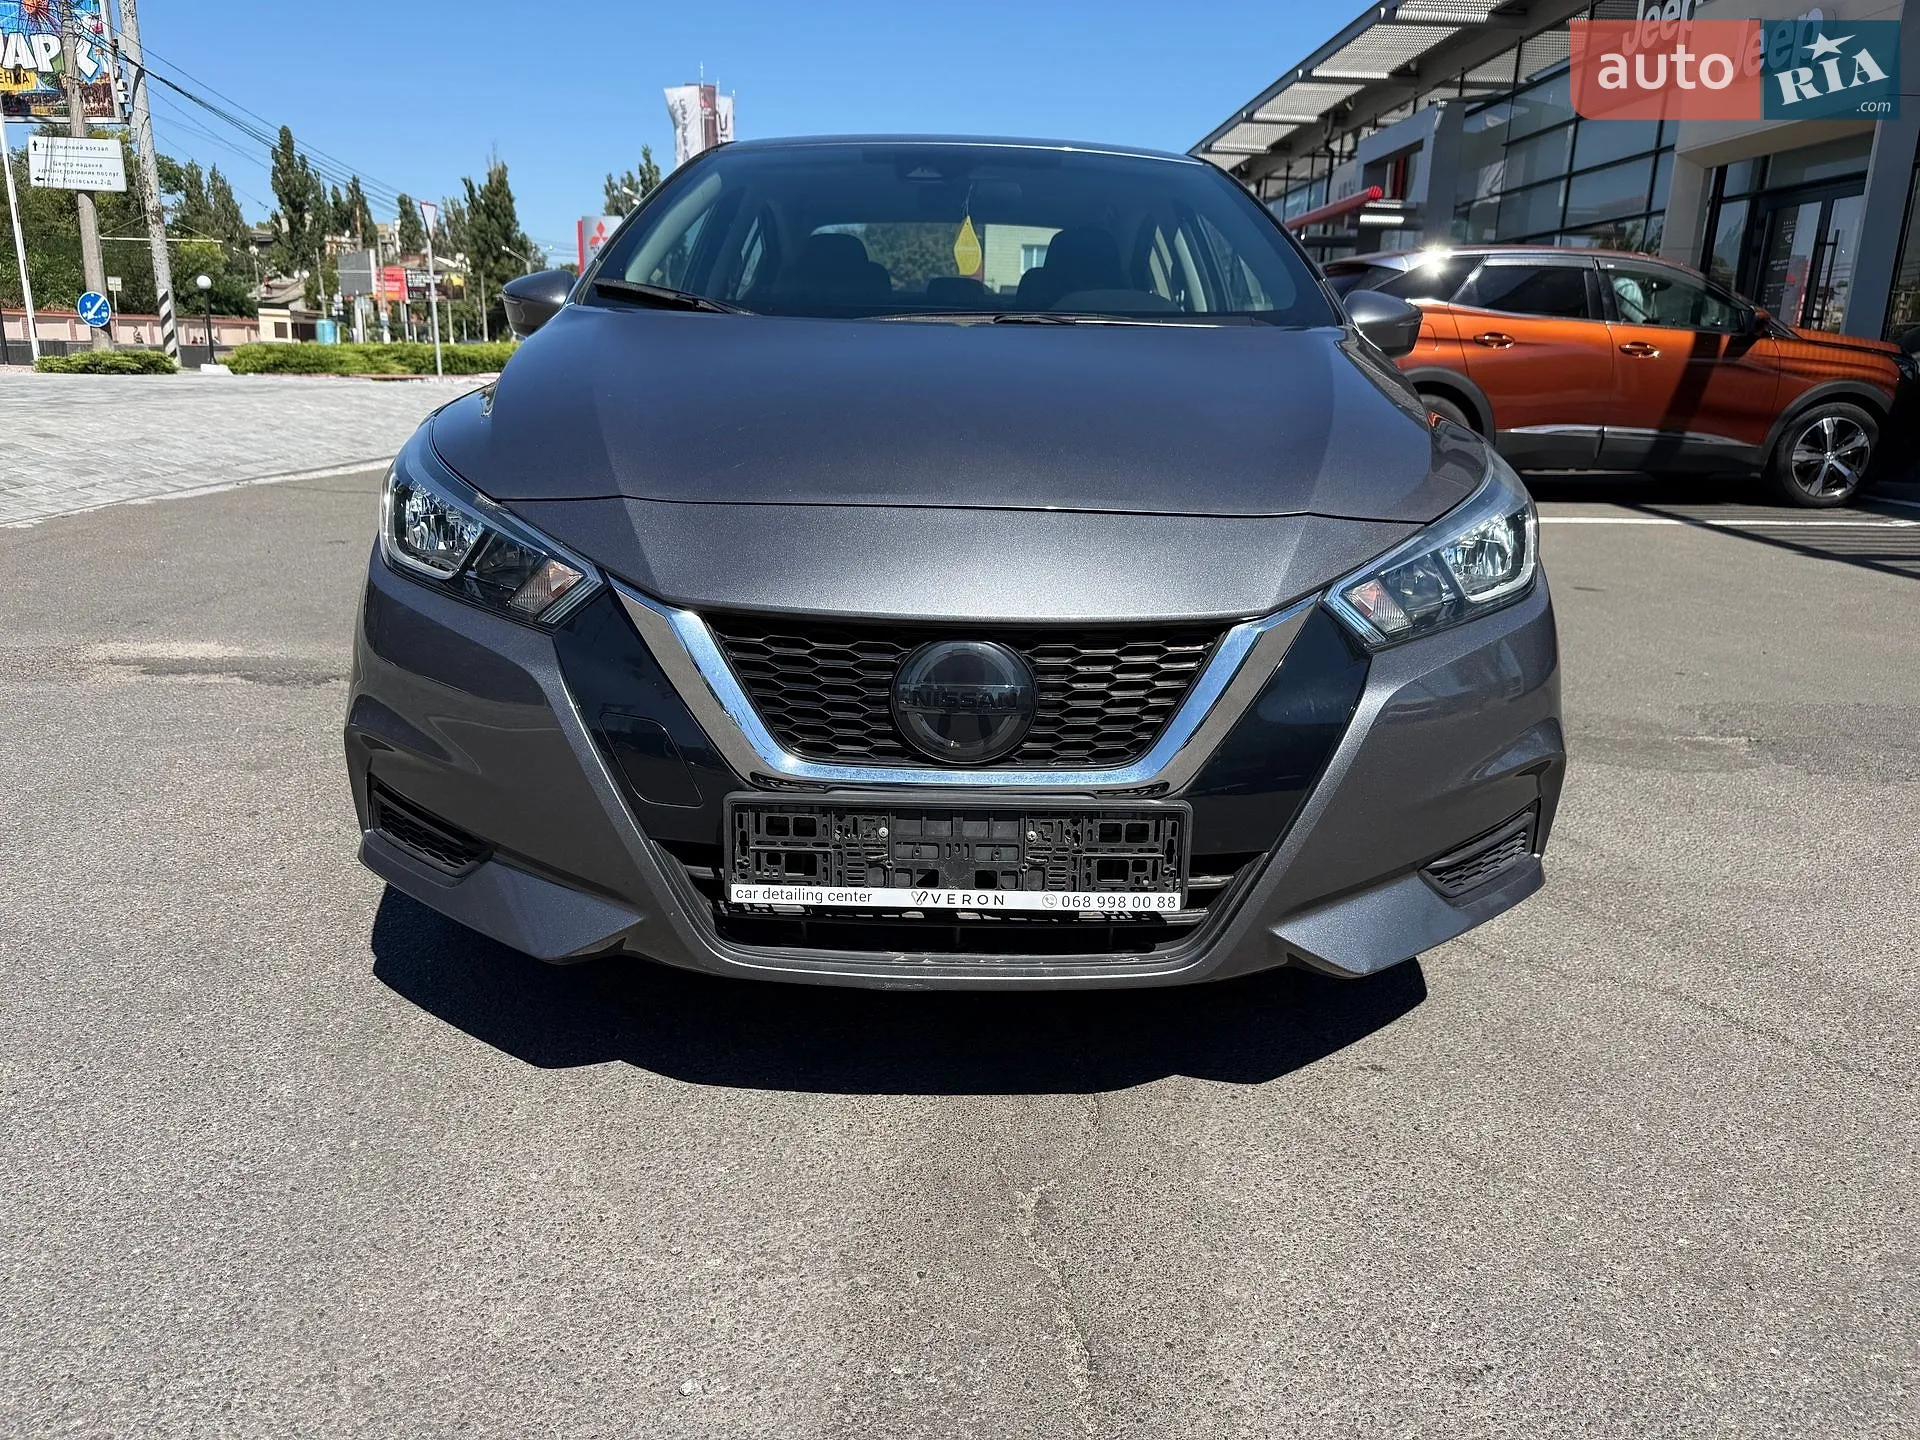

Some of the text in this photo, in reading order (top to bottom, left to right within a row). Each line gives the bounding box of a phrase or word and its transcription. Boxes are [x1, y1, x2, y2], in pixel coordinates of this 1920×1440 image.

[1621, 0, 1698, 56] Jeep
[908, 687, 1017, 709] NISSAN
[735, 887, 873, 904] car detailing center
[931, 893, 1004, 905] VERON
[1061, 895, 1176, 909] 068 998 00 88
